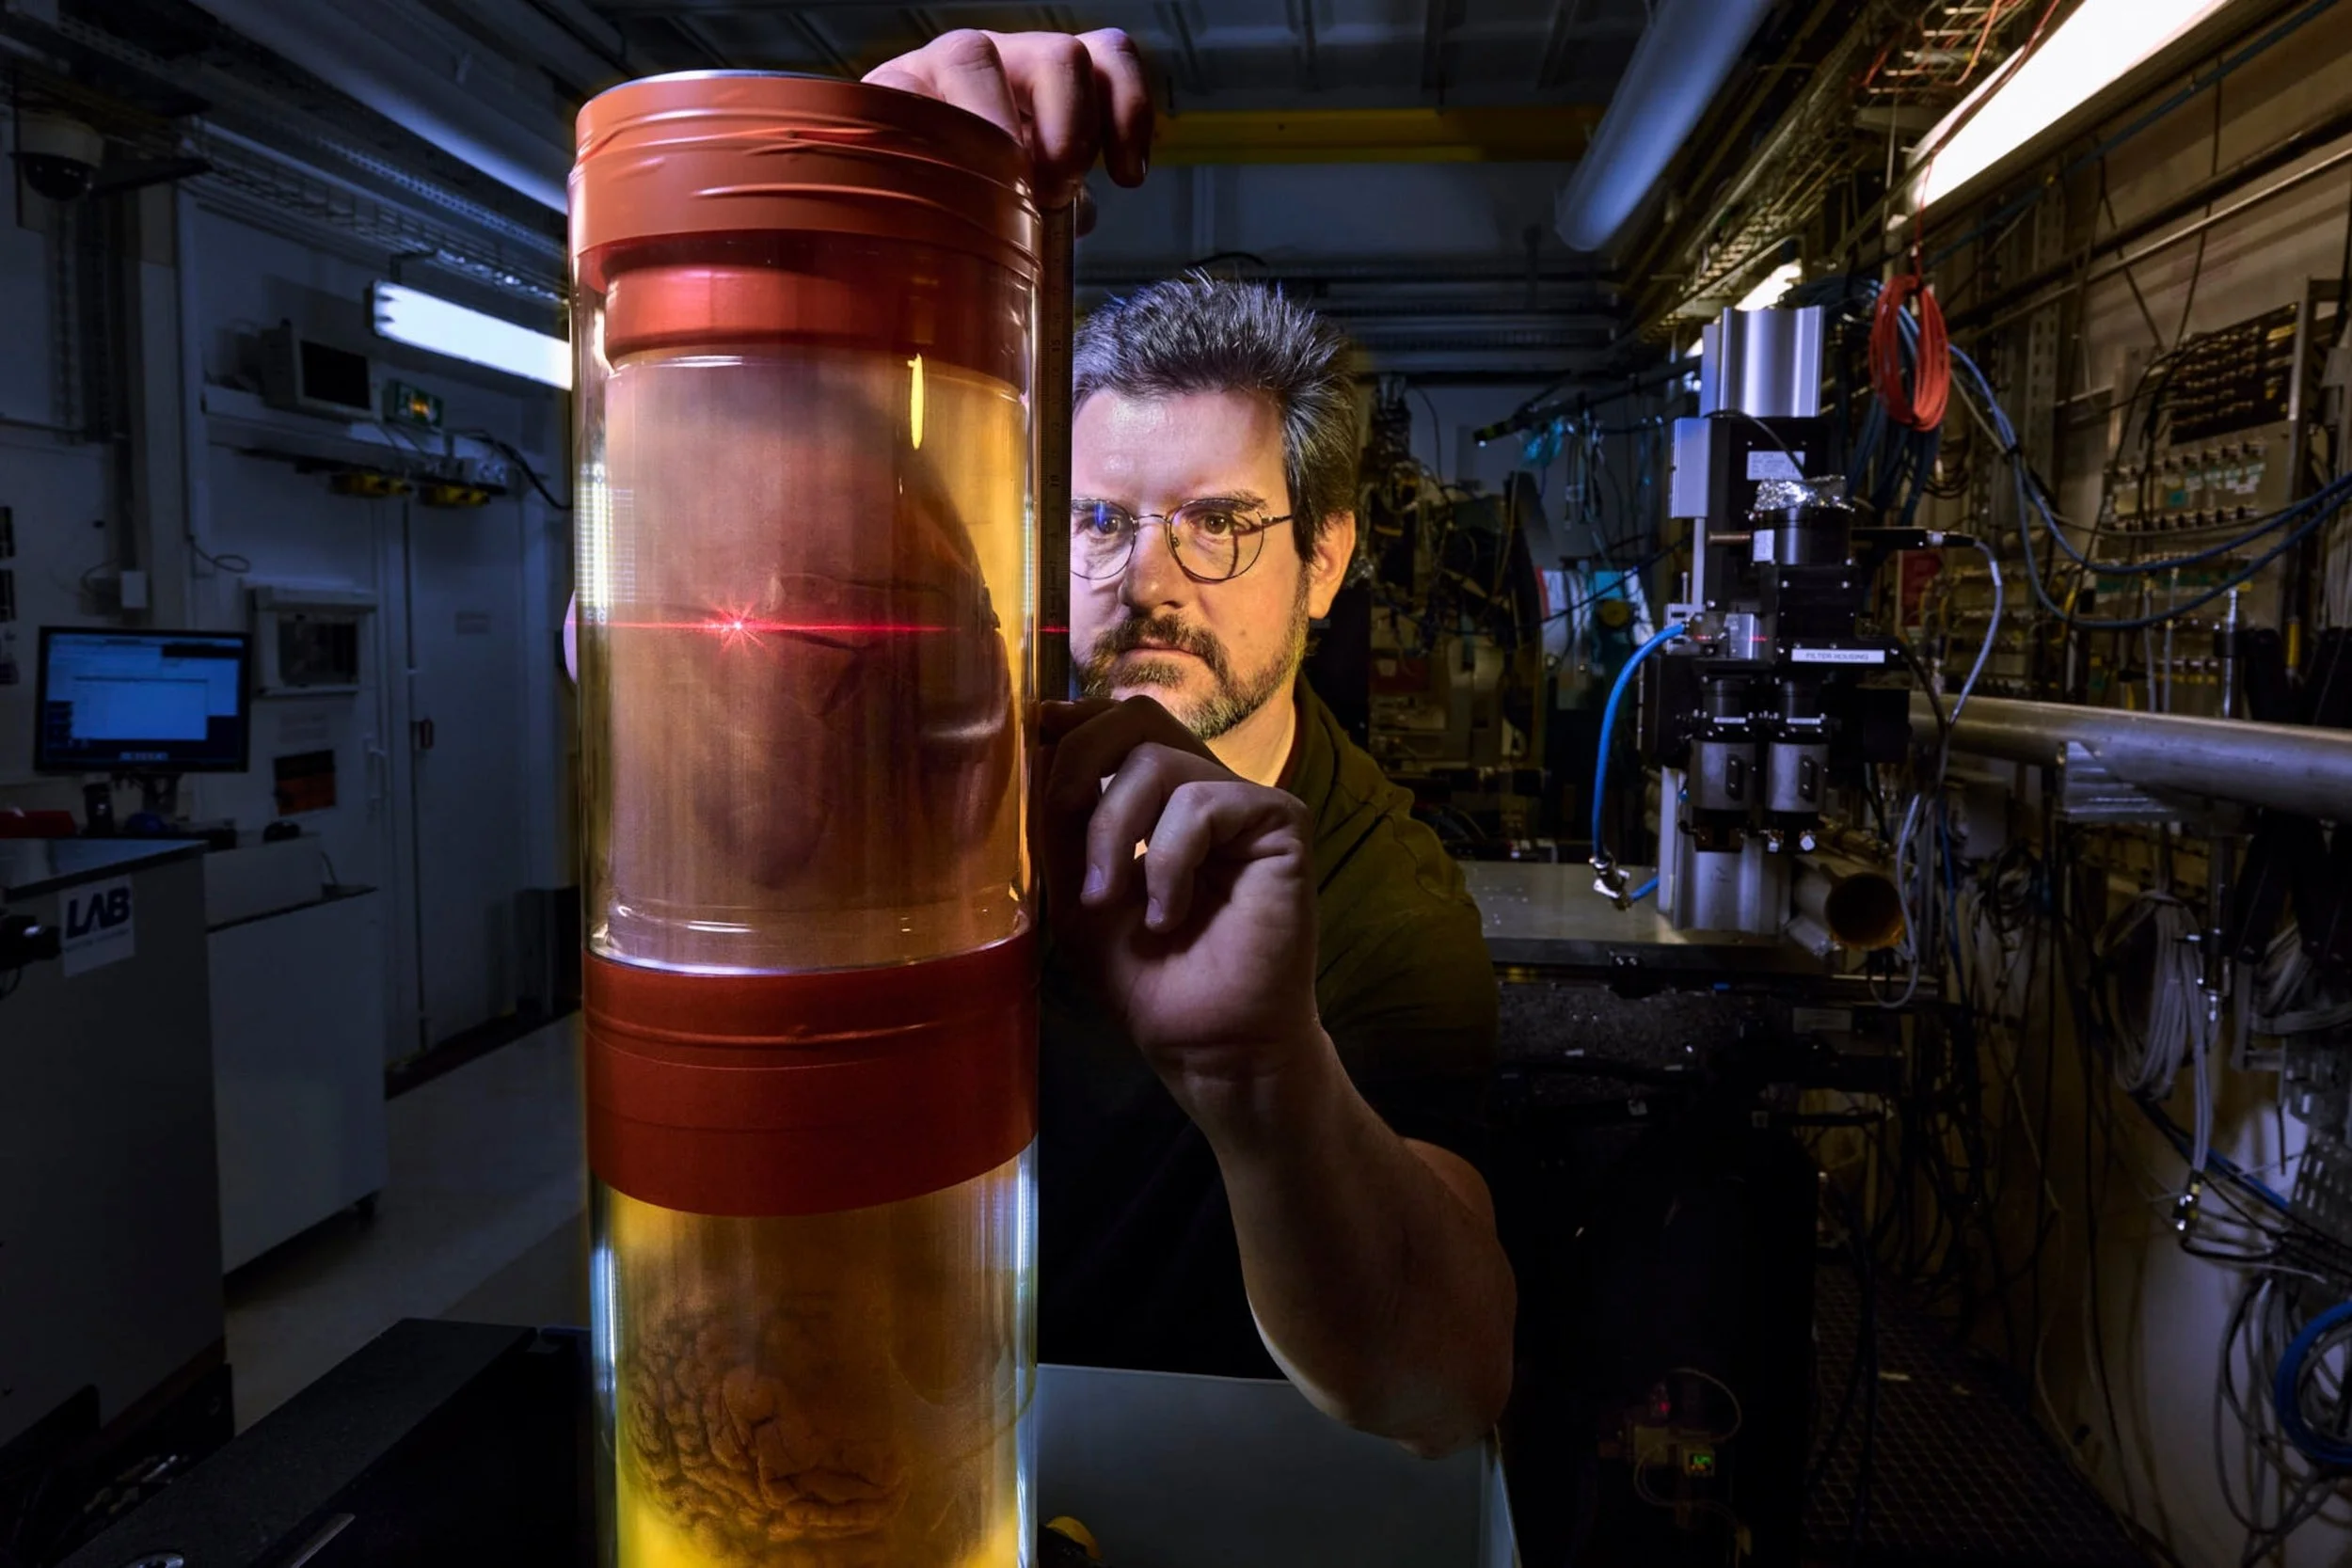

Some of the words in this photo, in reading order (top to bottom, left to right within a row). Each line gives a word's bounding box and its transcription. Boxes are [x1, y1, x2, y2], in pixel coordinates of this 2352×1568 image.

[1051, 339, 1061, 353] 15
[1049, 474, 1060, 488] 10
[66, 887, 130, 940] LAB
